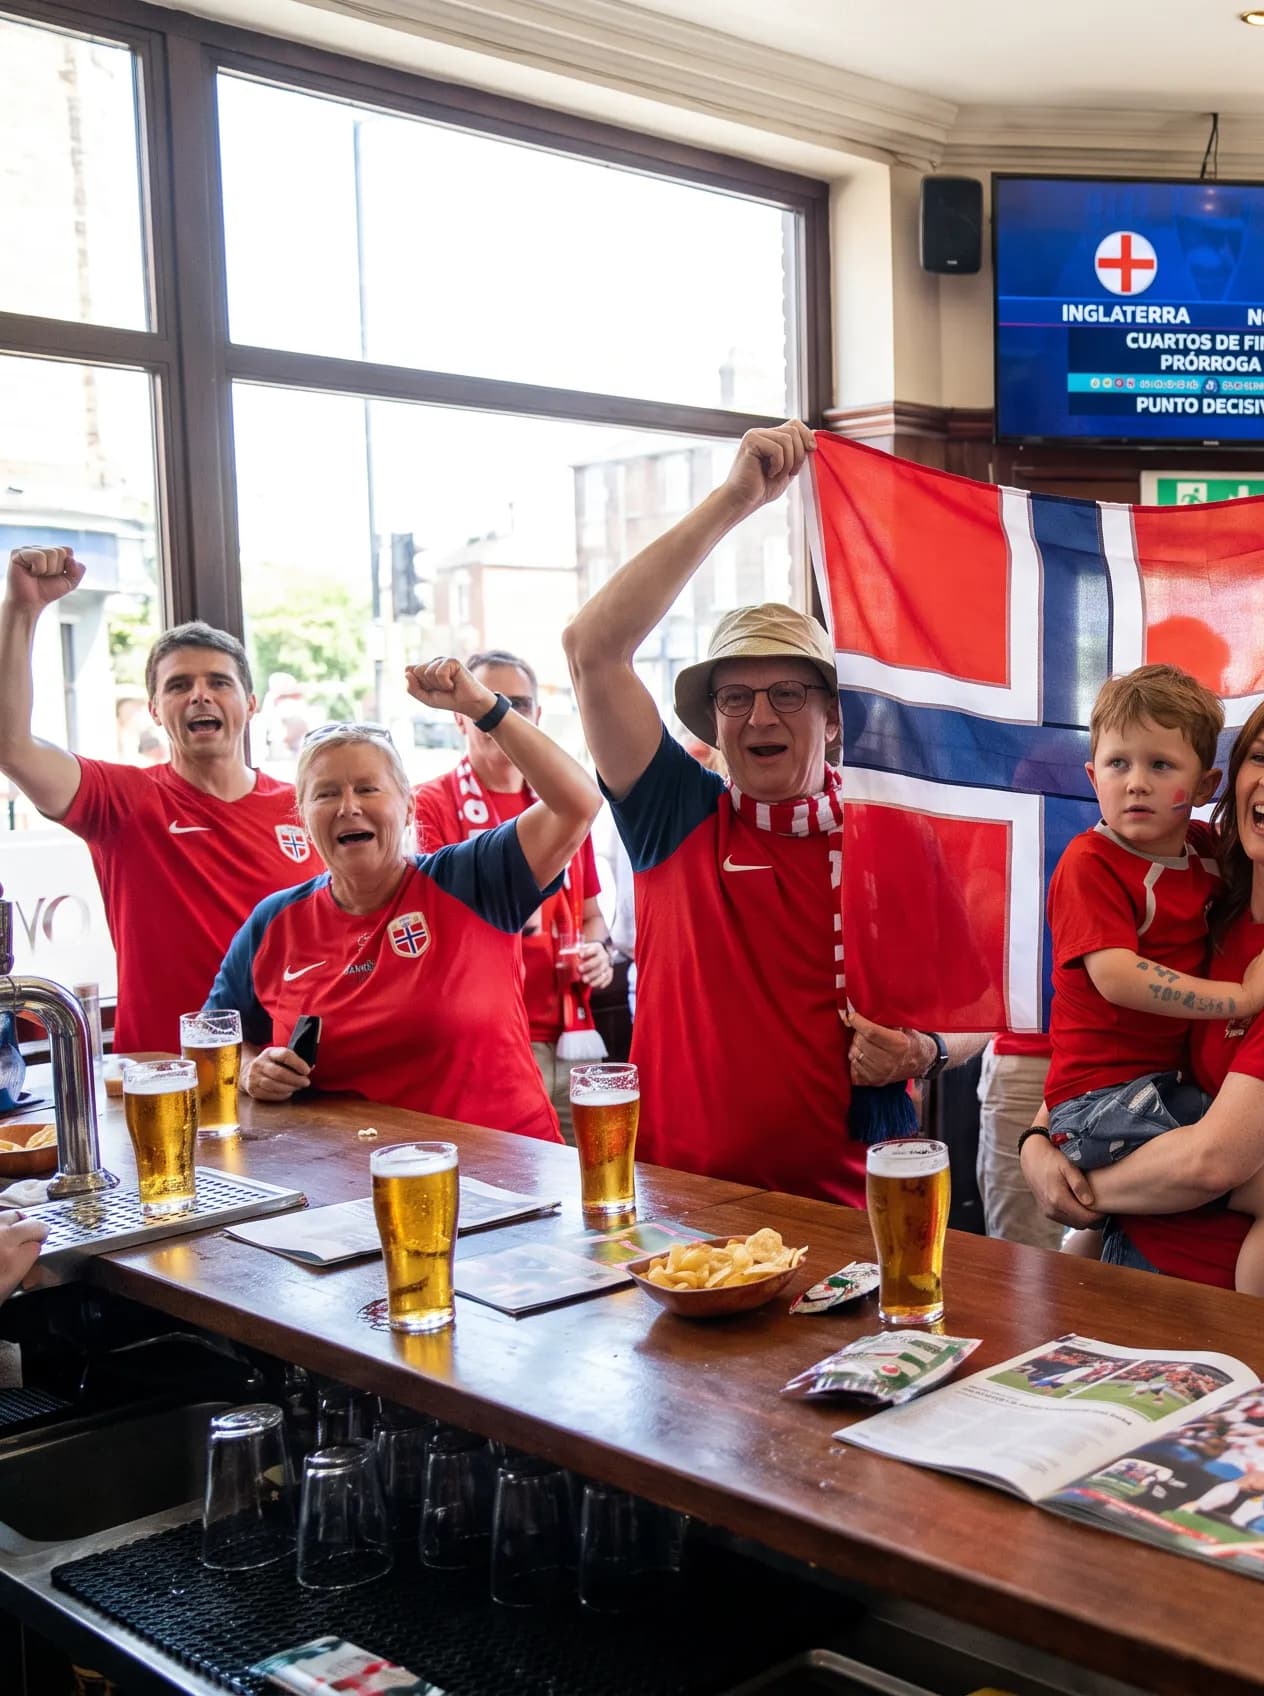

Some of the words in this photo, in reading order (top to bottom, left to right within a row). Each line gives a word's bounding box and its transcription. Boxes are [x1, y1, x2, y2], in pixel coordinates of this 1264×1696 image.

[1062, 304, 1191, 324] INGLATERRA
[1126, 332, 1212, 350] CUARTOS
[1215, 334, 1240, 351] DE
[1160, 351, 1262, 372] PRÓRROGA
[1136, 397, 1199, 413] PUNTO
